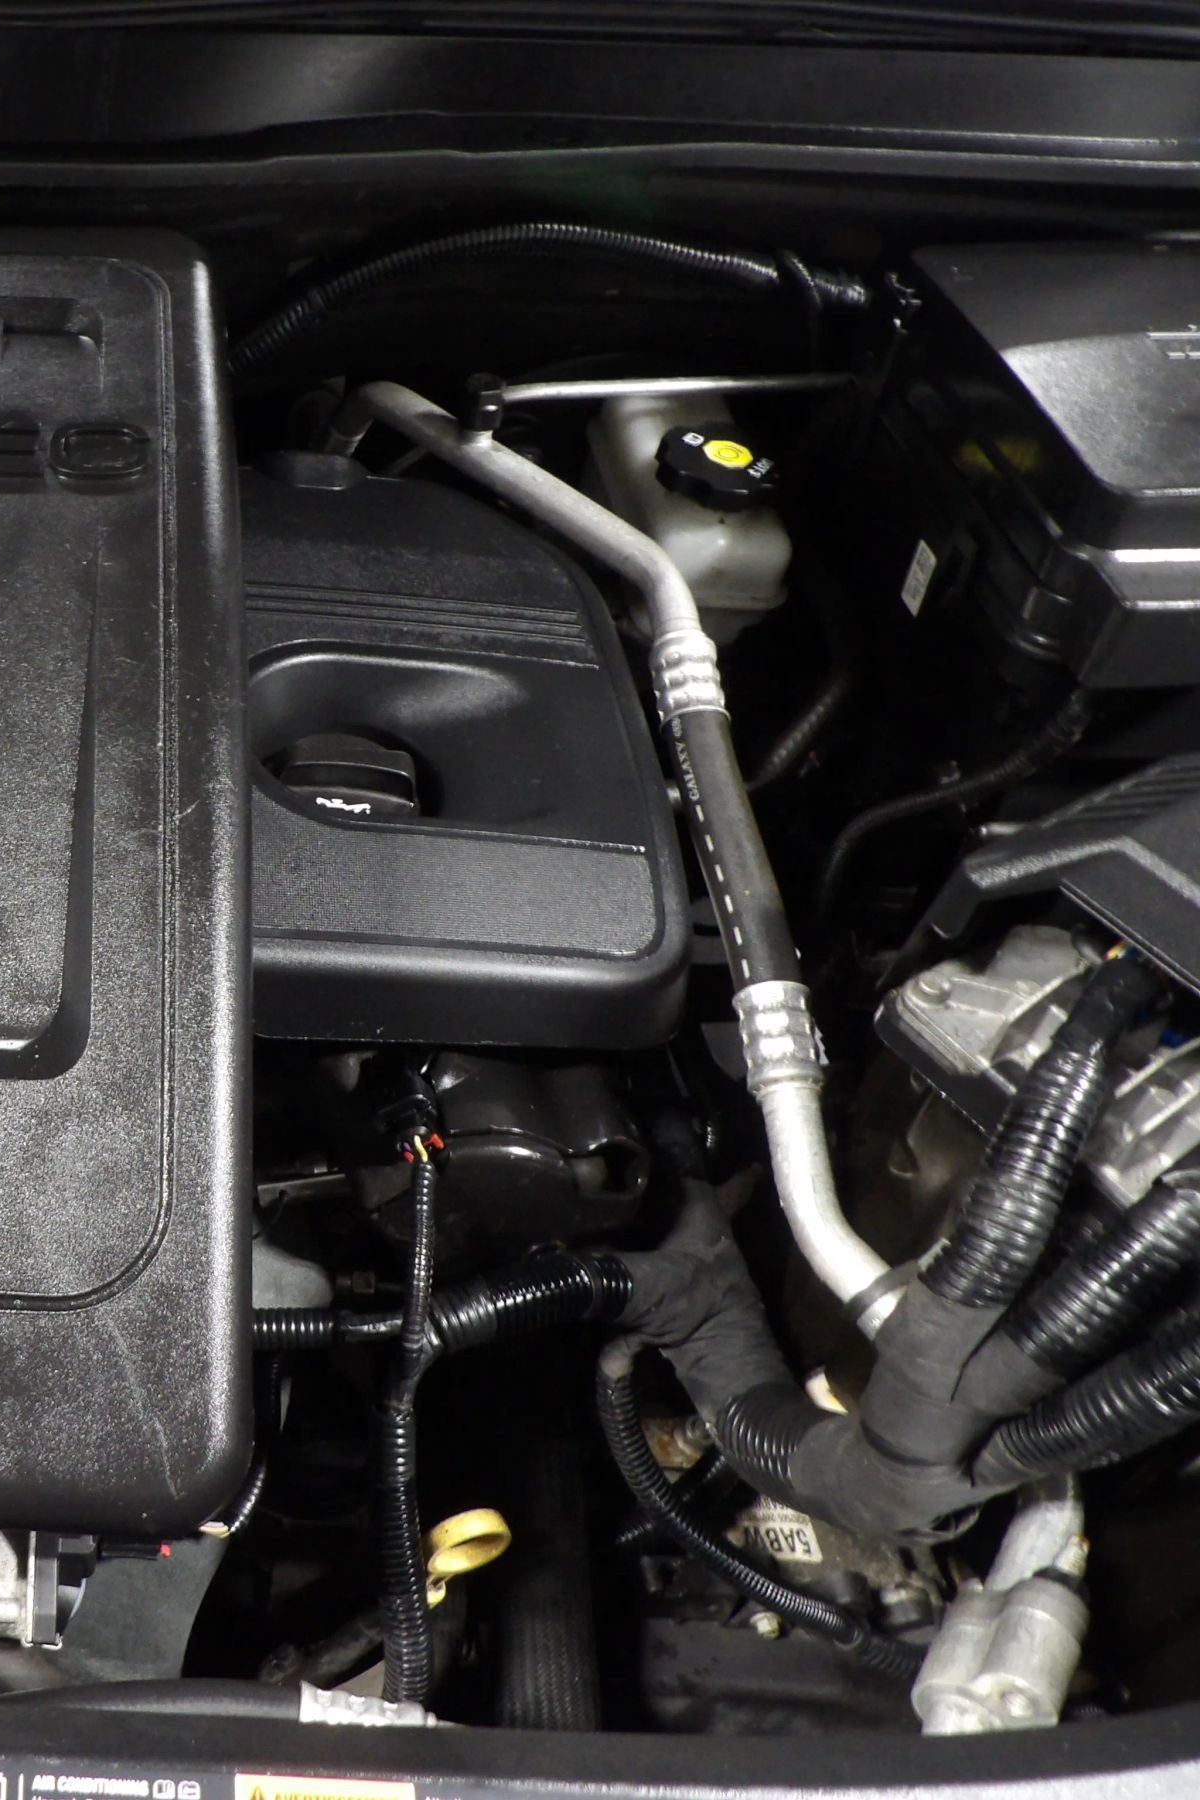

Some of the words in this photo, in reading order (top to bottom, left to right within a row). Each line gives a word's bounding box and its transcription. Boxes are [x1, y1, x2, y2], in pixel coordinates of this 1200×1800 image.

[675, 741, 700, 801] GALAXY
[743, 1526, 812, 1555] 5ABW
[32, 1774, 55, 1791] AIR
[57, 1775, 149, 1798] CONDITIONING
